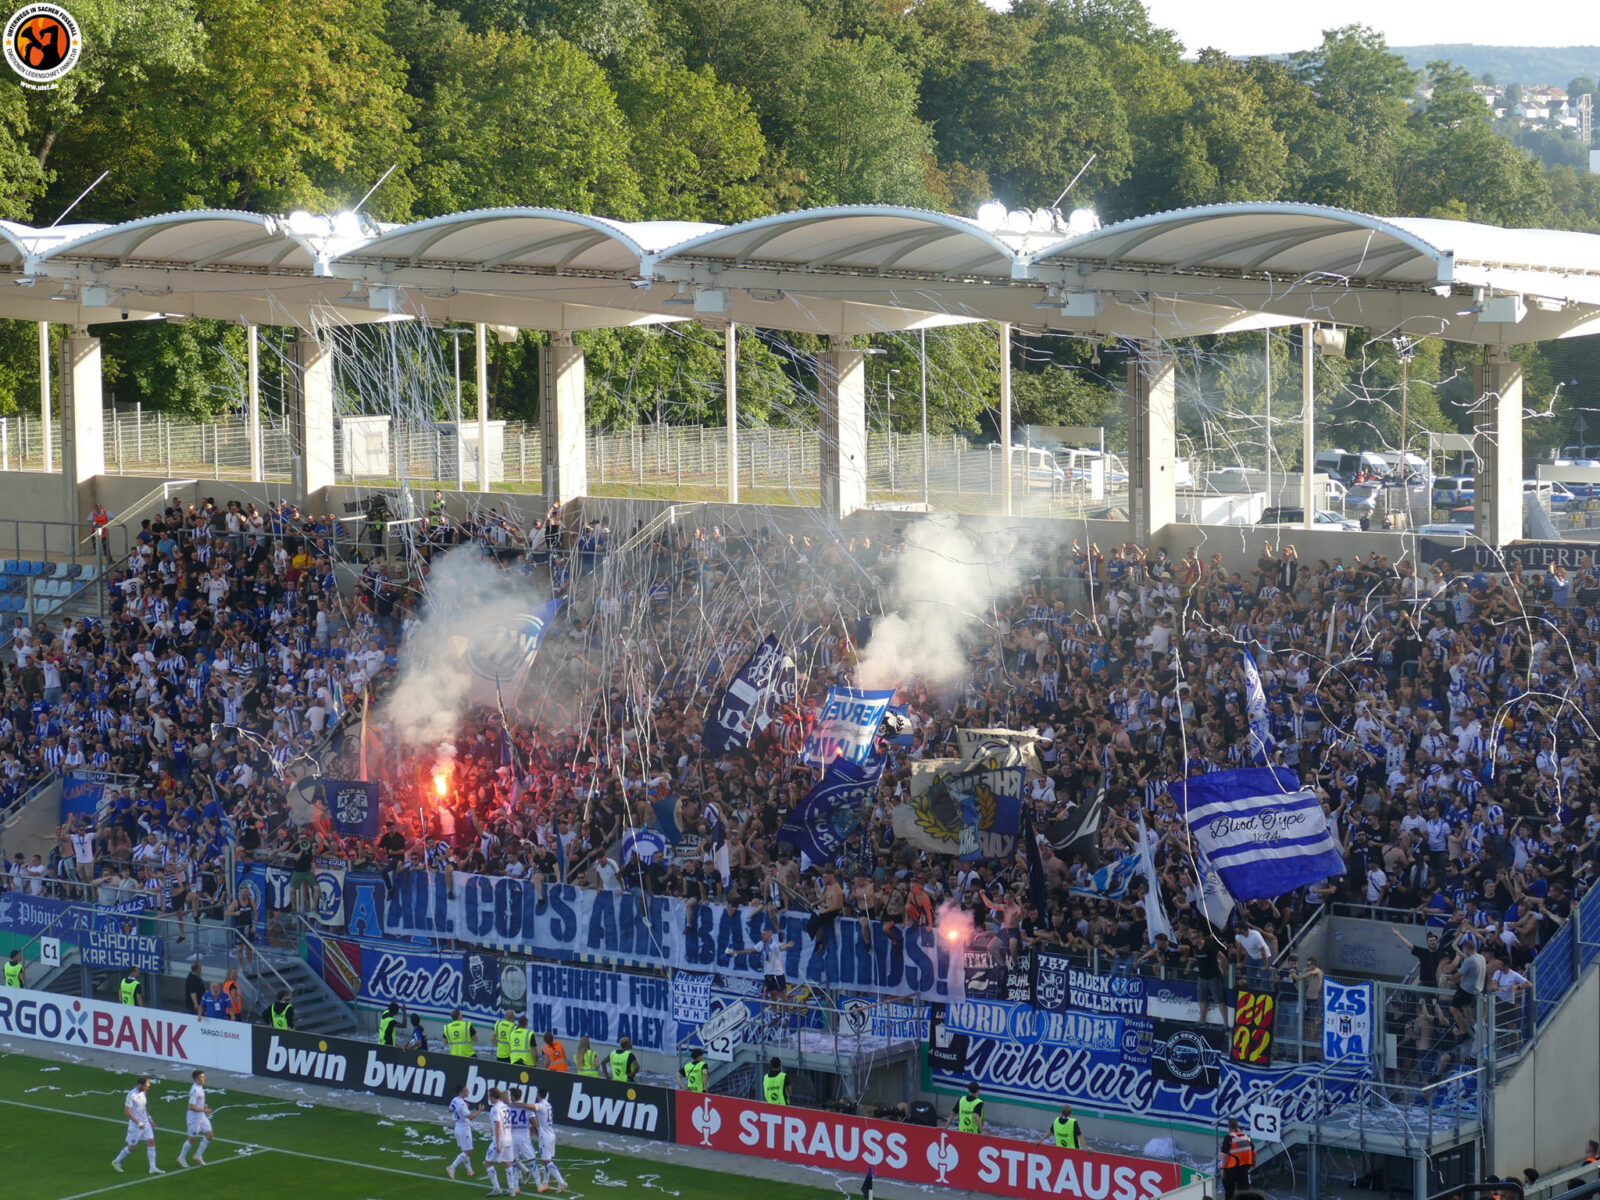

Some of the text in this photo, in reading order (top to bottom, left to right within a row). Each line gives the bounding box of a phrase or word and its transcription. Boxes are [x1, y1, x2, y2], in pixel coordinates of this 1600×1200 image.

[1210, 808, 1306, 838] Blood Type
[18, 901, 63, 929] Phönix
[386, 871, 455, 933] ALL
[464, 875, 578, 943] COPS
[587, 890, 671, 959] ARE
[43, 943, 58, 960] C1
[83, 948, 160, 971] KARLSRUHE
[532, 964, 621, 1004] FREIHEIT
[674, 983, 710, 994] KLINIK
[677, 972, 715, 984] NERVEN
[1069, 969, 1110, 993] BADEN
[674, 1008, 709, 1020] RUHE
[675, 995, 709, 1008] KARLS
[1069, 989, 1143, 1014] KOLLEKTIV
[1327, 986, 1366, 1015] ZS
[93, 1011, 188, 1059] BANK
[565, 1006, 609, 1041] UND
[617, 1013, 664, 1051] ALEX
[948, 1002, 1006, 1035] NORD
[1050, 1012, 1117, 1049] BADEN
[710, 1036, 730, 1054] C2
[1125, 1035, 1137, 1048] KSC
[1326, 1031, 1366, 1060] KA
[267, 1035, 347, 1082] bwin
[364, 1050, 446, 1098] bwin
[511, 1109, 527, 1125] 24
[567, 1082, 658, 1132] bwin
[1253, 1113, 1277, 1133] C3
[738, 1110, 909, 1168] STRAUSS
[977, 1146, 1163, 1200] STRAUSS
